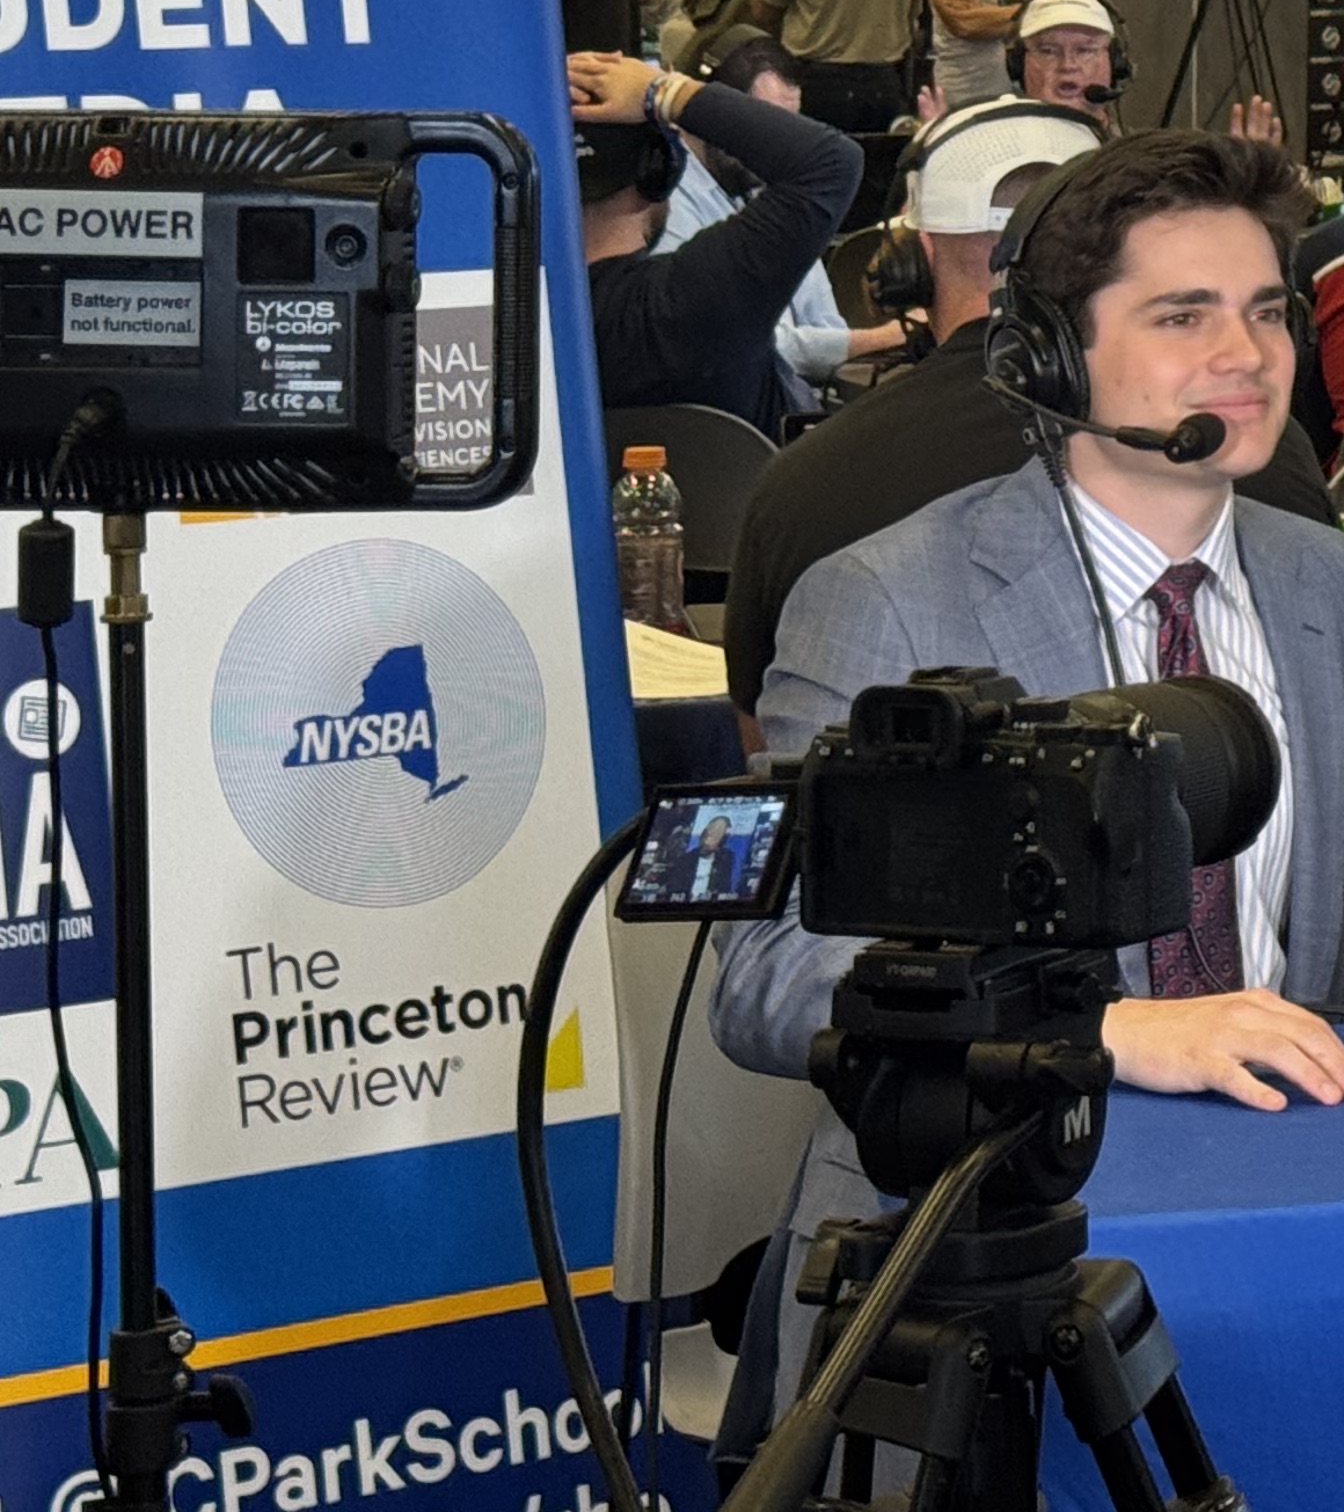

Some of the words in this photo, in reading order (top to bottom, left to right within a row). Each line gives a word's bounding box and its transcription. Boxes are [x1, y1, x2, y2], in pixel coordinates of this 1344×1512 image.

[56, 207, 195, 240] POWER
[70, 291, 133, 313] Battery
[136, 296, 194, 313] power
[245, 300, 336, 319] LYKOS
[69, 316, 101, 333] not
[103, 316, 197, 335] functional.
[245, 318, 343, 336] bi-color
[298, 708, 433, 764] NYSBA
[225, 941, 341, 1001] The
[231, 983, 529, 1066] Princeton
